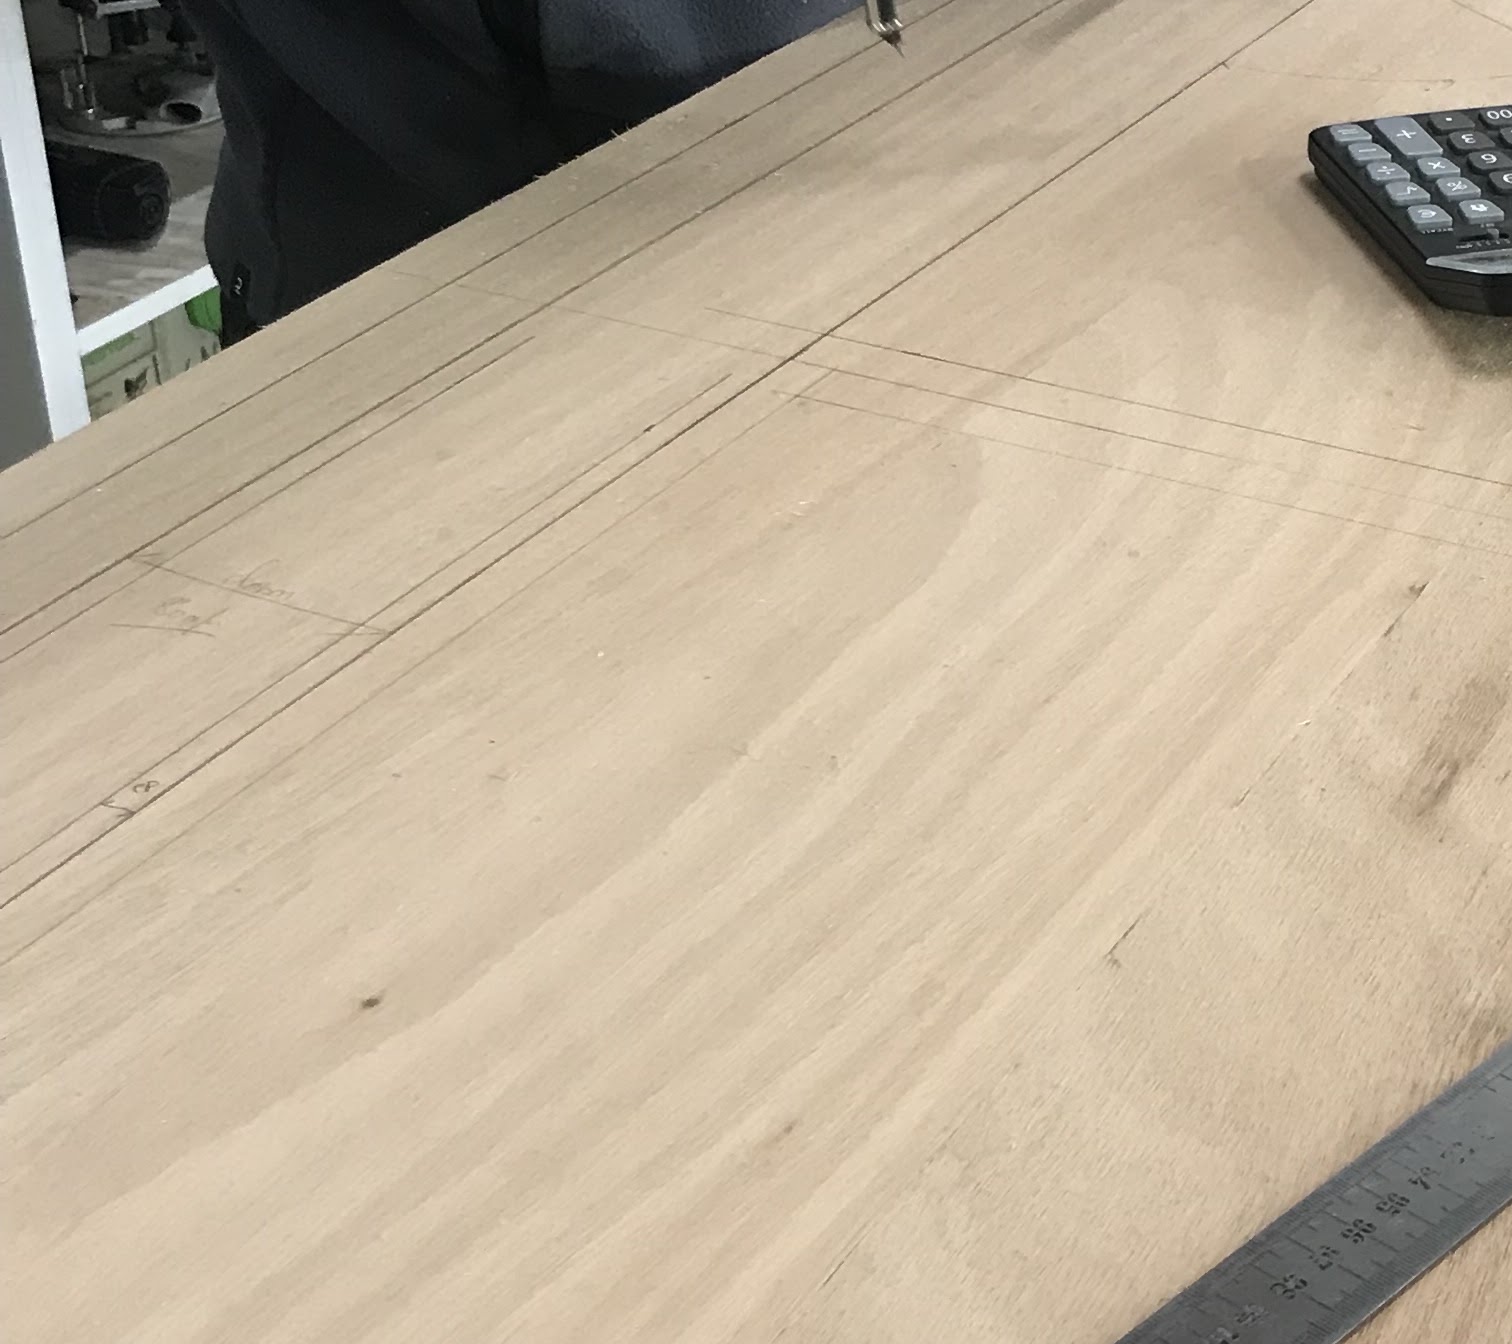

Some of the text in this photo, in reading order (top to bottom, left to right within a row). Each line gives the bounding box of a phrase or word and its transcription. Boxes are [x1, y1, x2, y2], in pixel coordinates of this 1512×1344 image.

[1486, 109, 1512, 120] 00
[1461, 133, 1476, 144] 3
[1480, 153, 1497, 164] 6
[1338, 1217, 1378, 1244] 96
